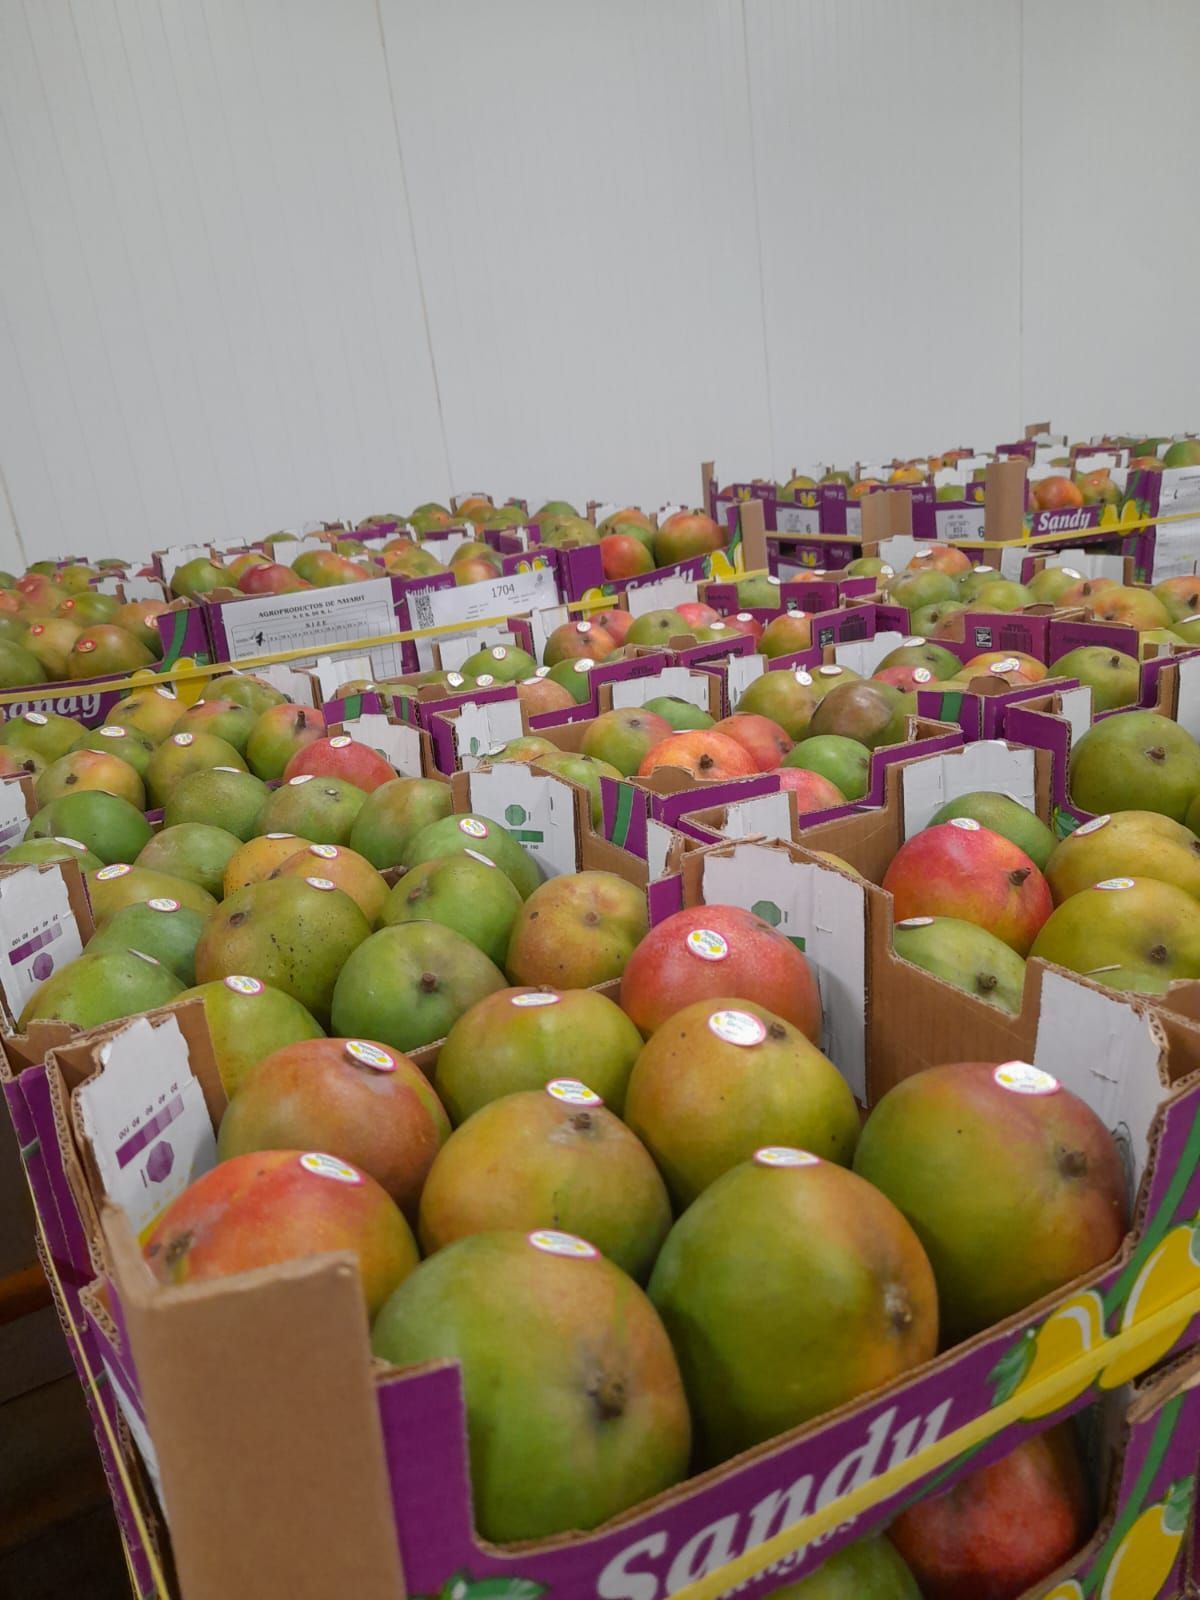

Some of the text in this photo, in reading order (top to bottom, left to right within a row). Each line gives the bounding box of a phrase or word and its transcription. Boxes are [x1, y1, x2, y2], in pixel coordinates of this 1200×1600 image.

[1038, 507, 1092, 531] Sandy
[491, 583, 516, 599] 1704
[0, 693, 100, 720] andy
